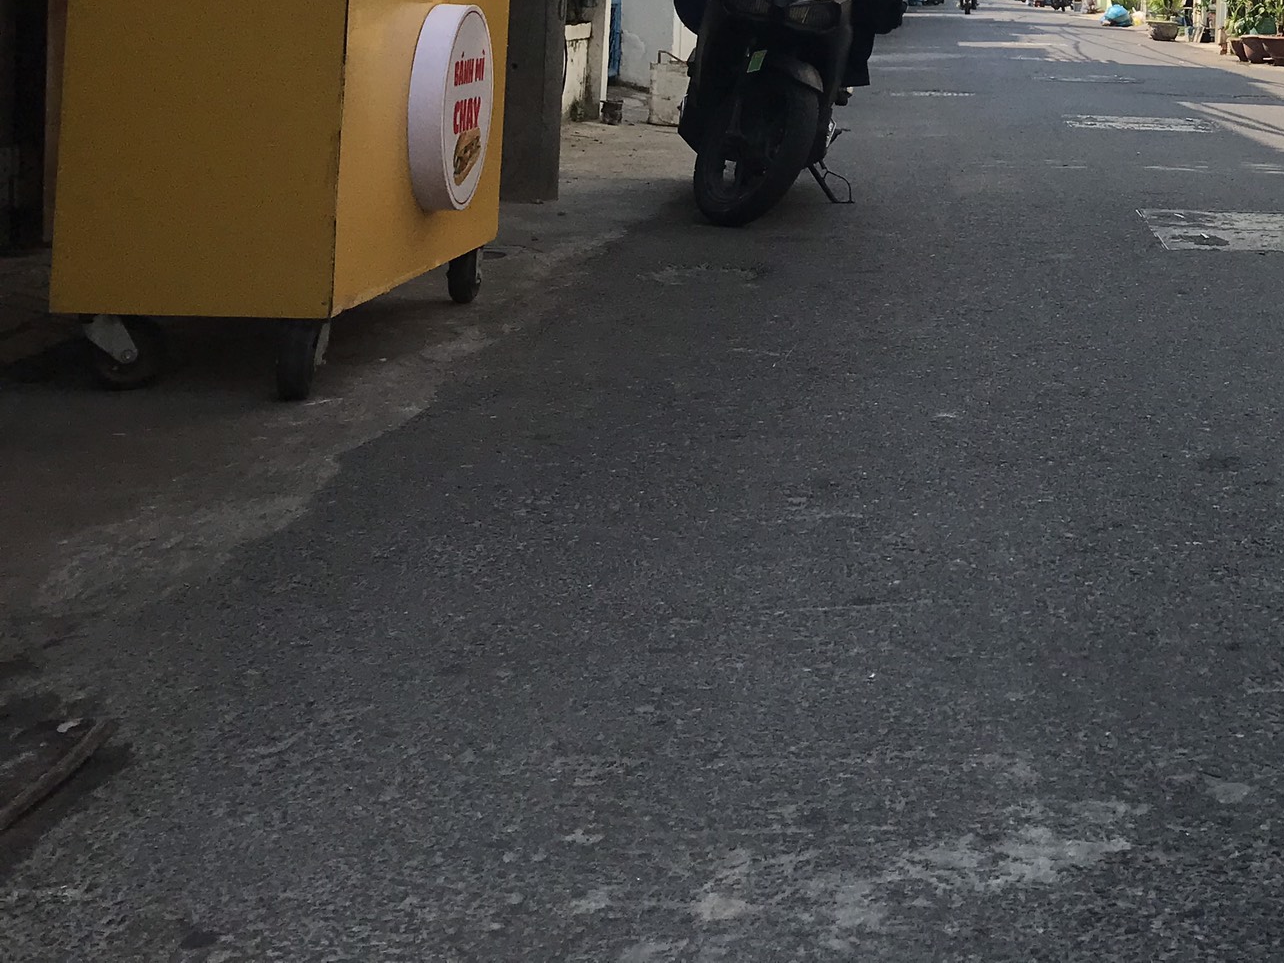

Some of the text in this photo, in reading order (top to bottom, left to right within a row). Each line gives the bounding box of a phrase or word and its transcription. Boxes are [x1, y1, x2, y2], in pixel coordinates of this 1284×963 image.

[454, 50, 485, 86] BÁNH MÌ
[454, 97, 481, 135] CHAY
